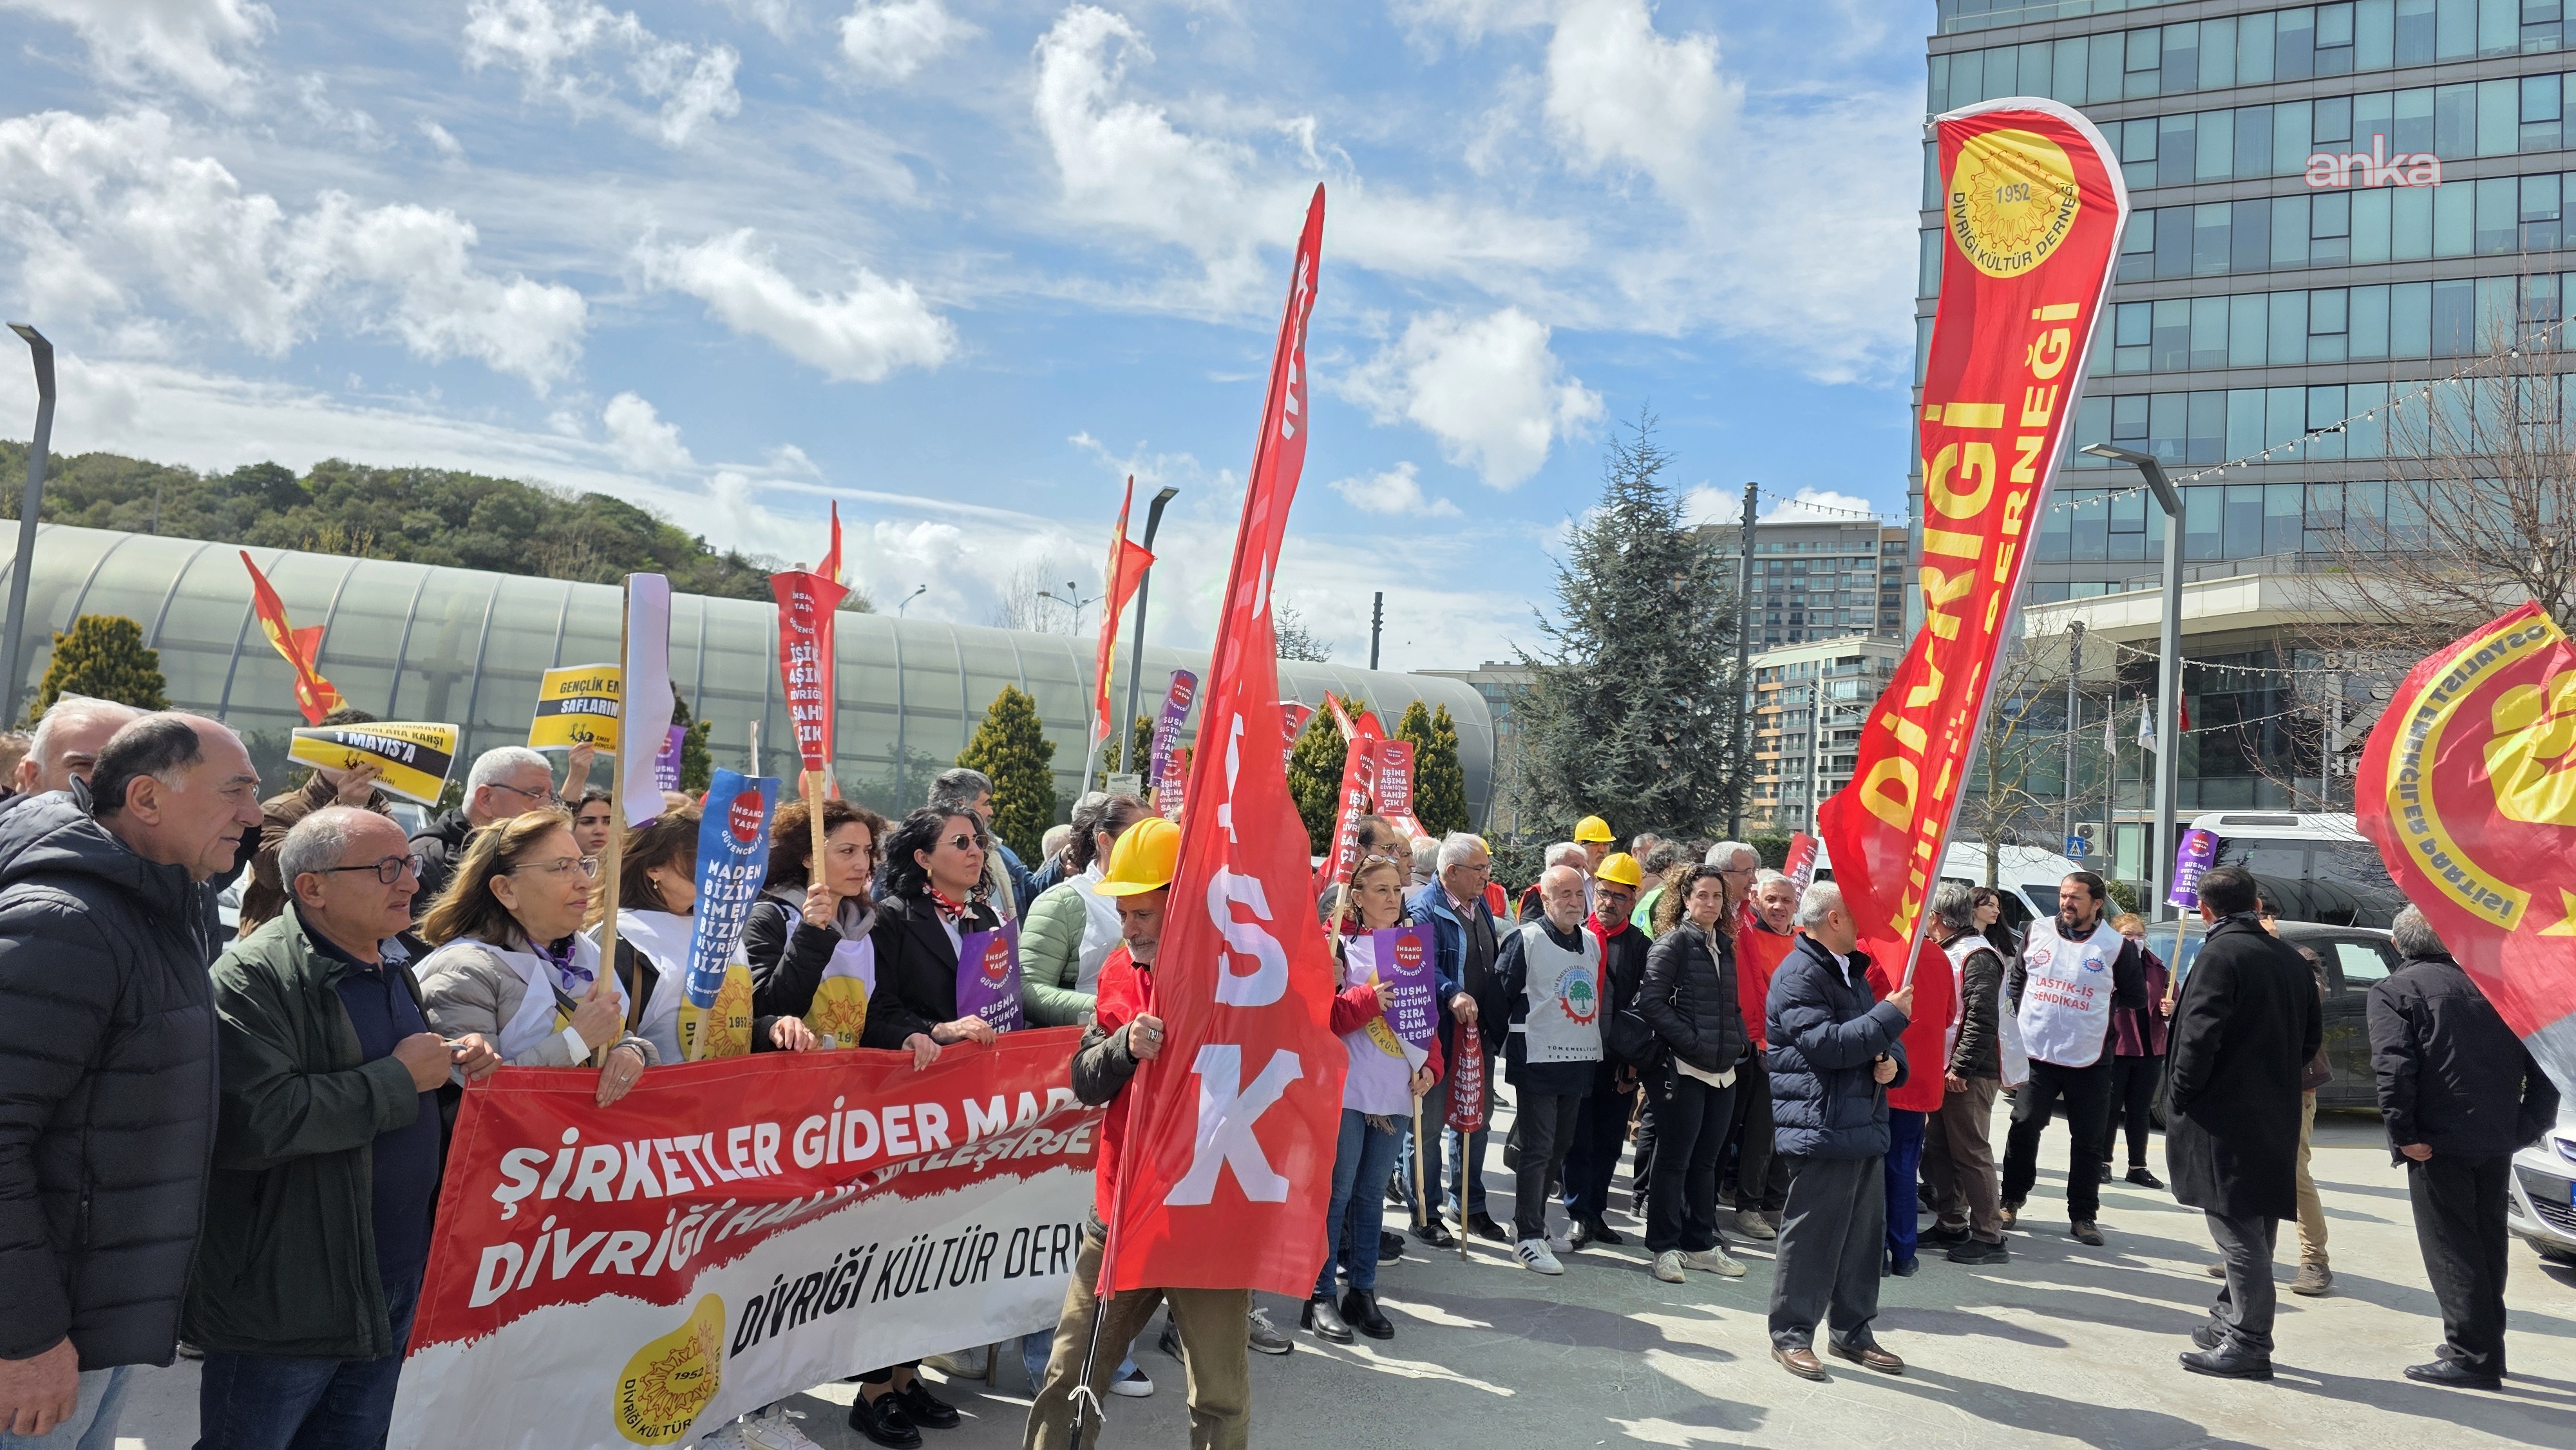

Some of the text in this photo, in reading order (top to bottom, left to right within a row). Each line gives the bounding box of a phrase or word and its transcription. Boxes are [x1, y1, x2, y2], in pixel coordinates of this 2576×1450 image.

[1996, 182, 2031, 204] 1952
[1953, 192, 1982, 254] DİVRİĞİ
[1977, 249, 2032, 271] KÜLTÜR
[560, 677, 603, 695] GENÇLİK
[336, 731, 344, 742] 1
[412, 732, 444, 749] KARŞI
[1383, 767, 1405, 777] İŞİNE
[1160, 779, 1182, 789] İŞİNE
[1160, 789, 1184, 798] AŞINA
[1381, 790, 1407, 798] SAHİP
[708, 859, 762, 880] MADEN
[2184, 862, 2206, 871] SUSMA
[1393, 984, 1427, 996] SUSMA
[980, 993, 1014, 1017] SUSMA
[2034, 992, 2090, 1011] SENDİKASI
[1399, 1007, 1425, 1019] SIRA
[1399, 1018, 1427, 1030] SANA
[1459, 1053, 1480, 1069] İŞİNE
[1456, 1069, 1480, 1083] AŞINA
[1454, 1089, 1480, 1104] SAHİP
[491, 1126, 784, 1221] ŞİRKETLER
[793, 1095, 951, 1169] GİDER
[469, 1198, 737, 1309] DİVRİĞİ
[730, 1243, 878, 1359] DİVRİĞİ
[878, 1226, 998, 1304] KÜLTÜR
[675, 1366, 705, 1380] 1952
[623, 1379, 692, 1438] DİVRİĞİ KÜLTÜR
